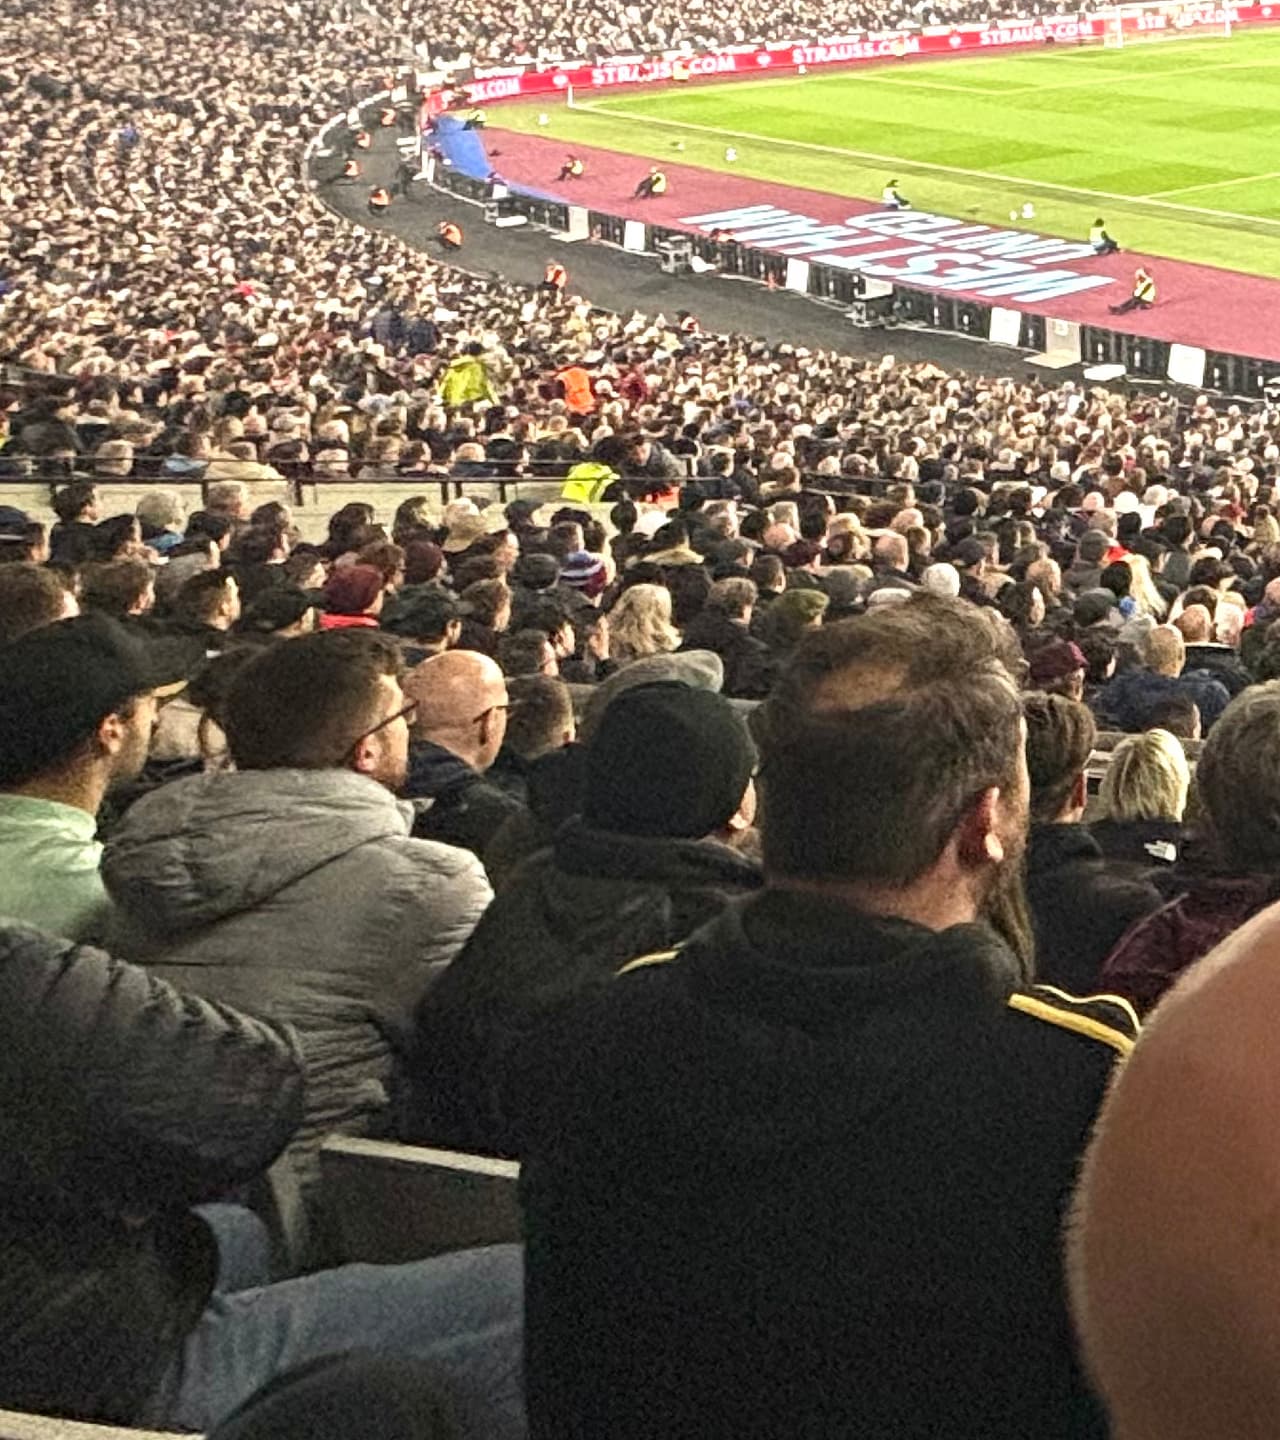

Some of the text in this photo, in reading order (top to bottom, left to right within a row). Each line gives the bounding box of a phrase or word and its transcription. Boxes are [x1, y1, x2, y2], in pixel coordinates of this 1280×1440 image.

[792, 38, 919, 64] STRAUSS.CM
[678, 204, 1118, 302] WEST HAM
[845, 211, 1099, 264] UNITED
